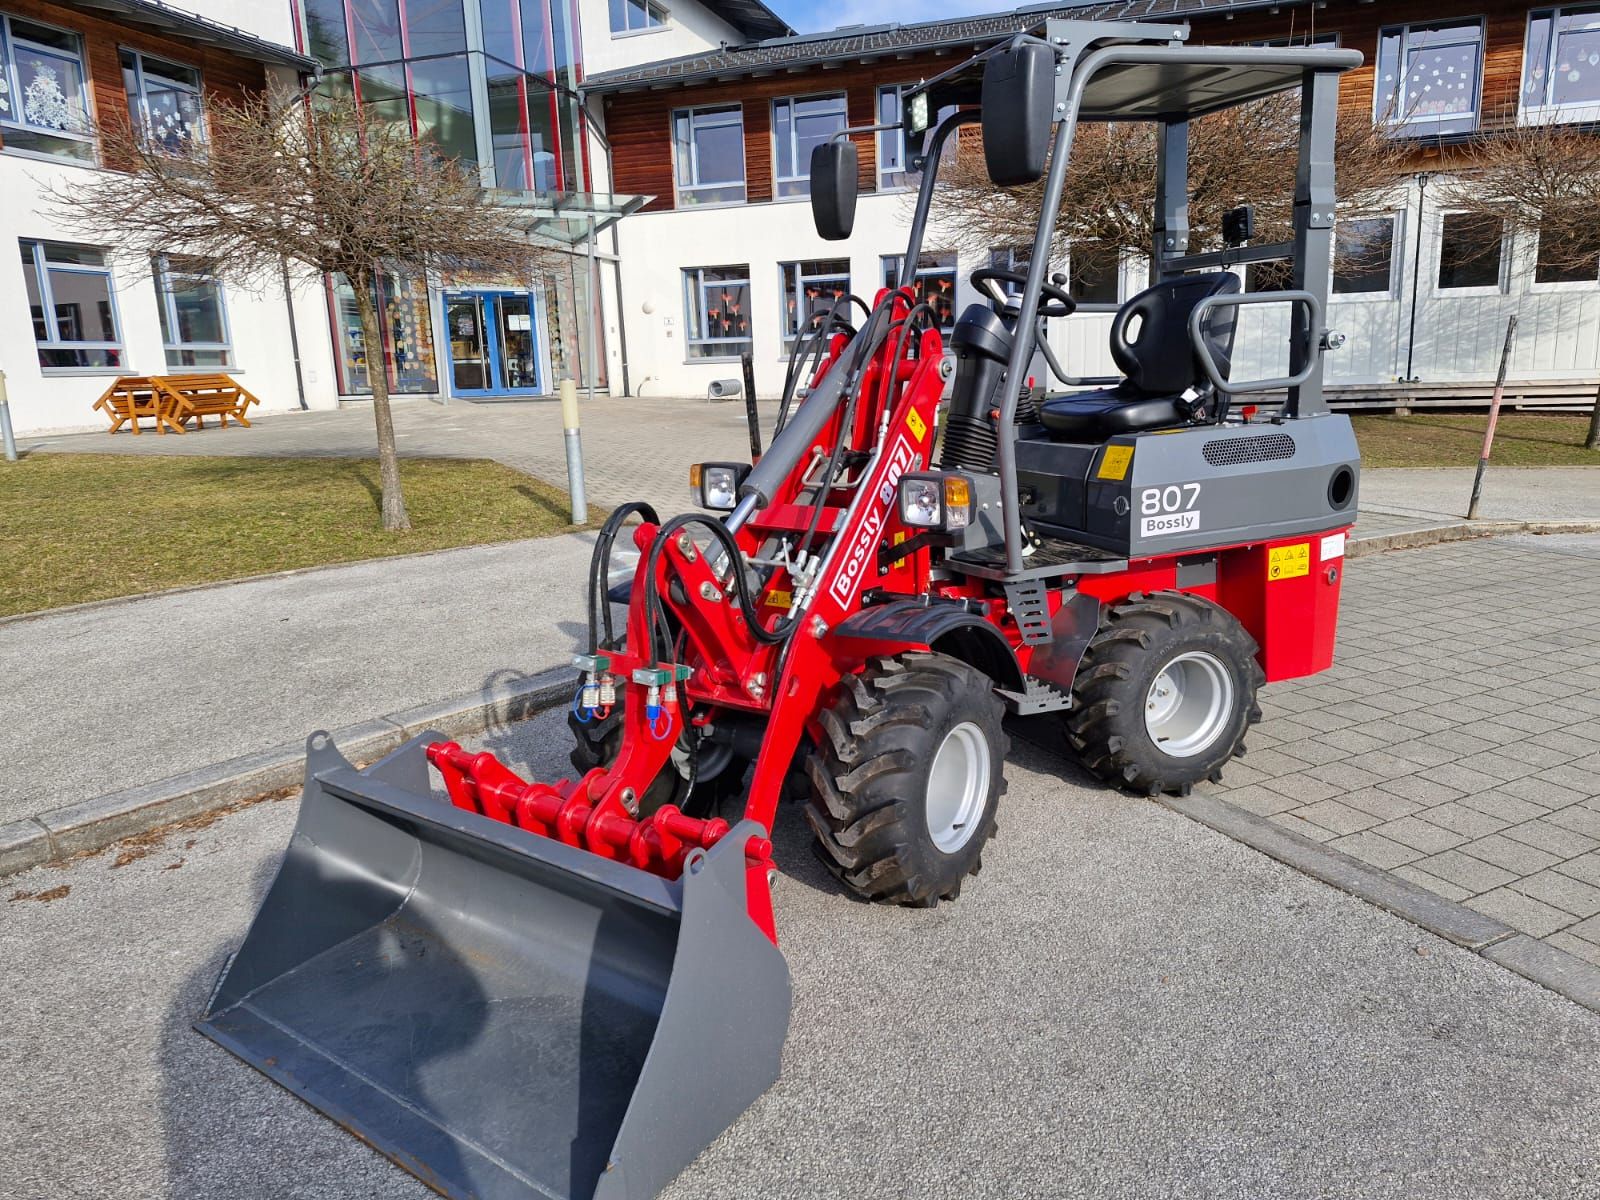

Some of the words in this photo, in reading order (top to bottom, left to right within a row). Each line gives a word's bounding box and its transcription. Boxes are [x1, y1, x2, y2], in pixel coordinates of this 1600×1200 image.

[1141, 483, 1201, 515] 807
[836, 508, 881, 597] Bossly
[880, 447, 908, 505] 807
[1146, 515, 1194, 532] Bossly
